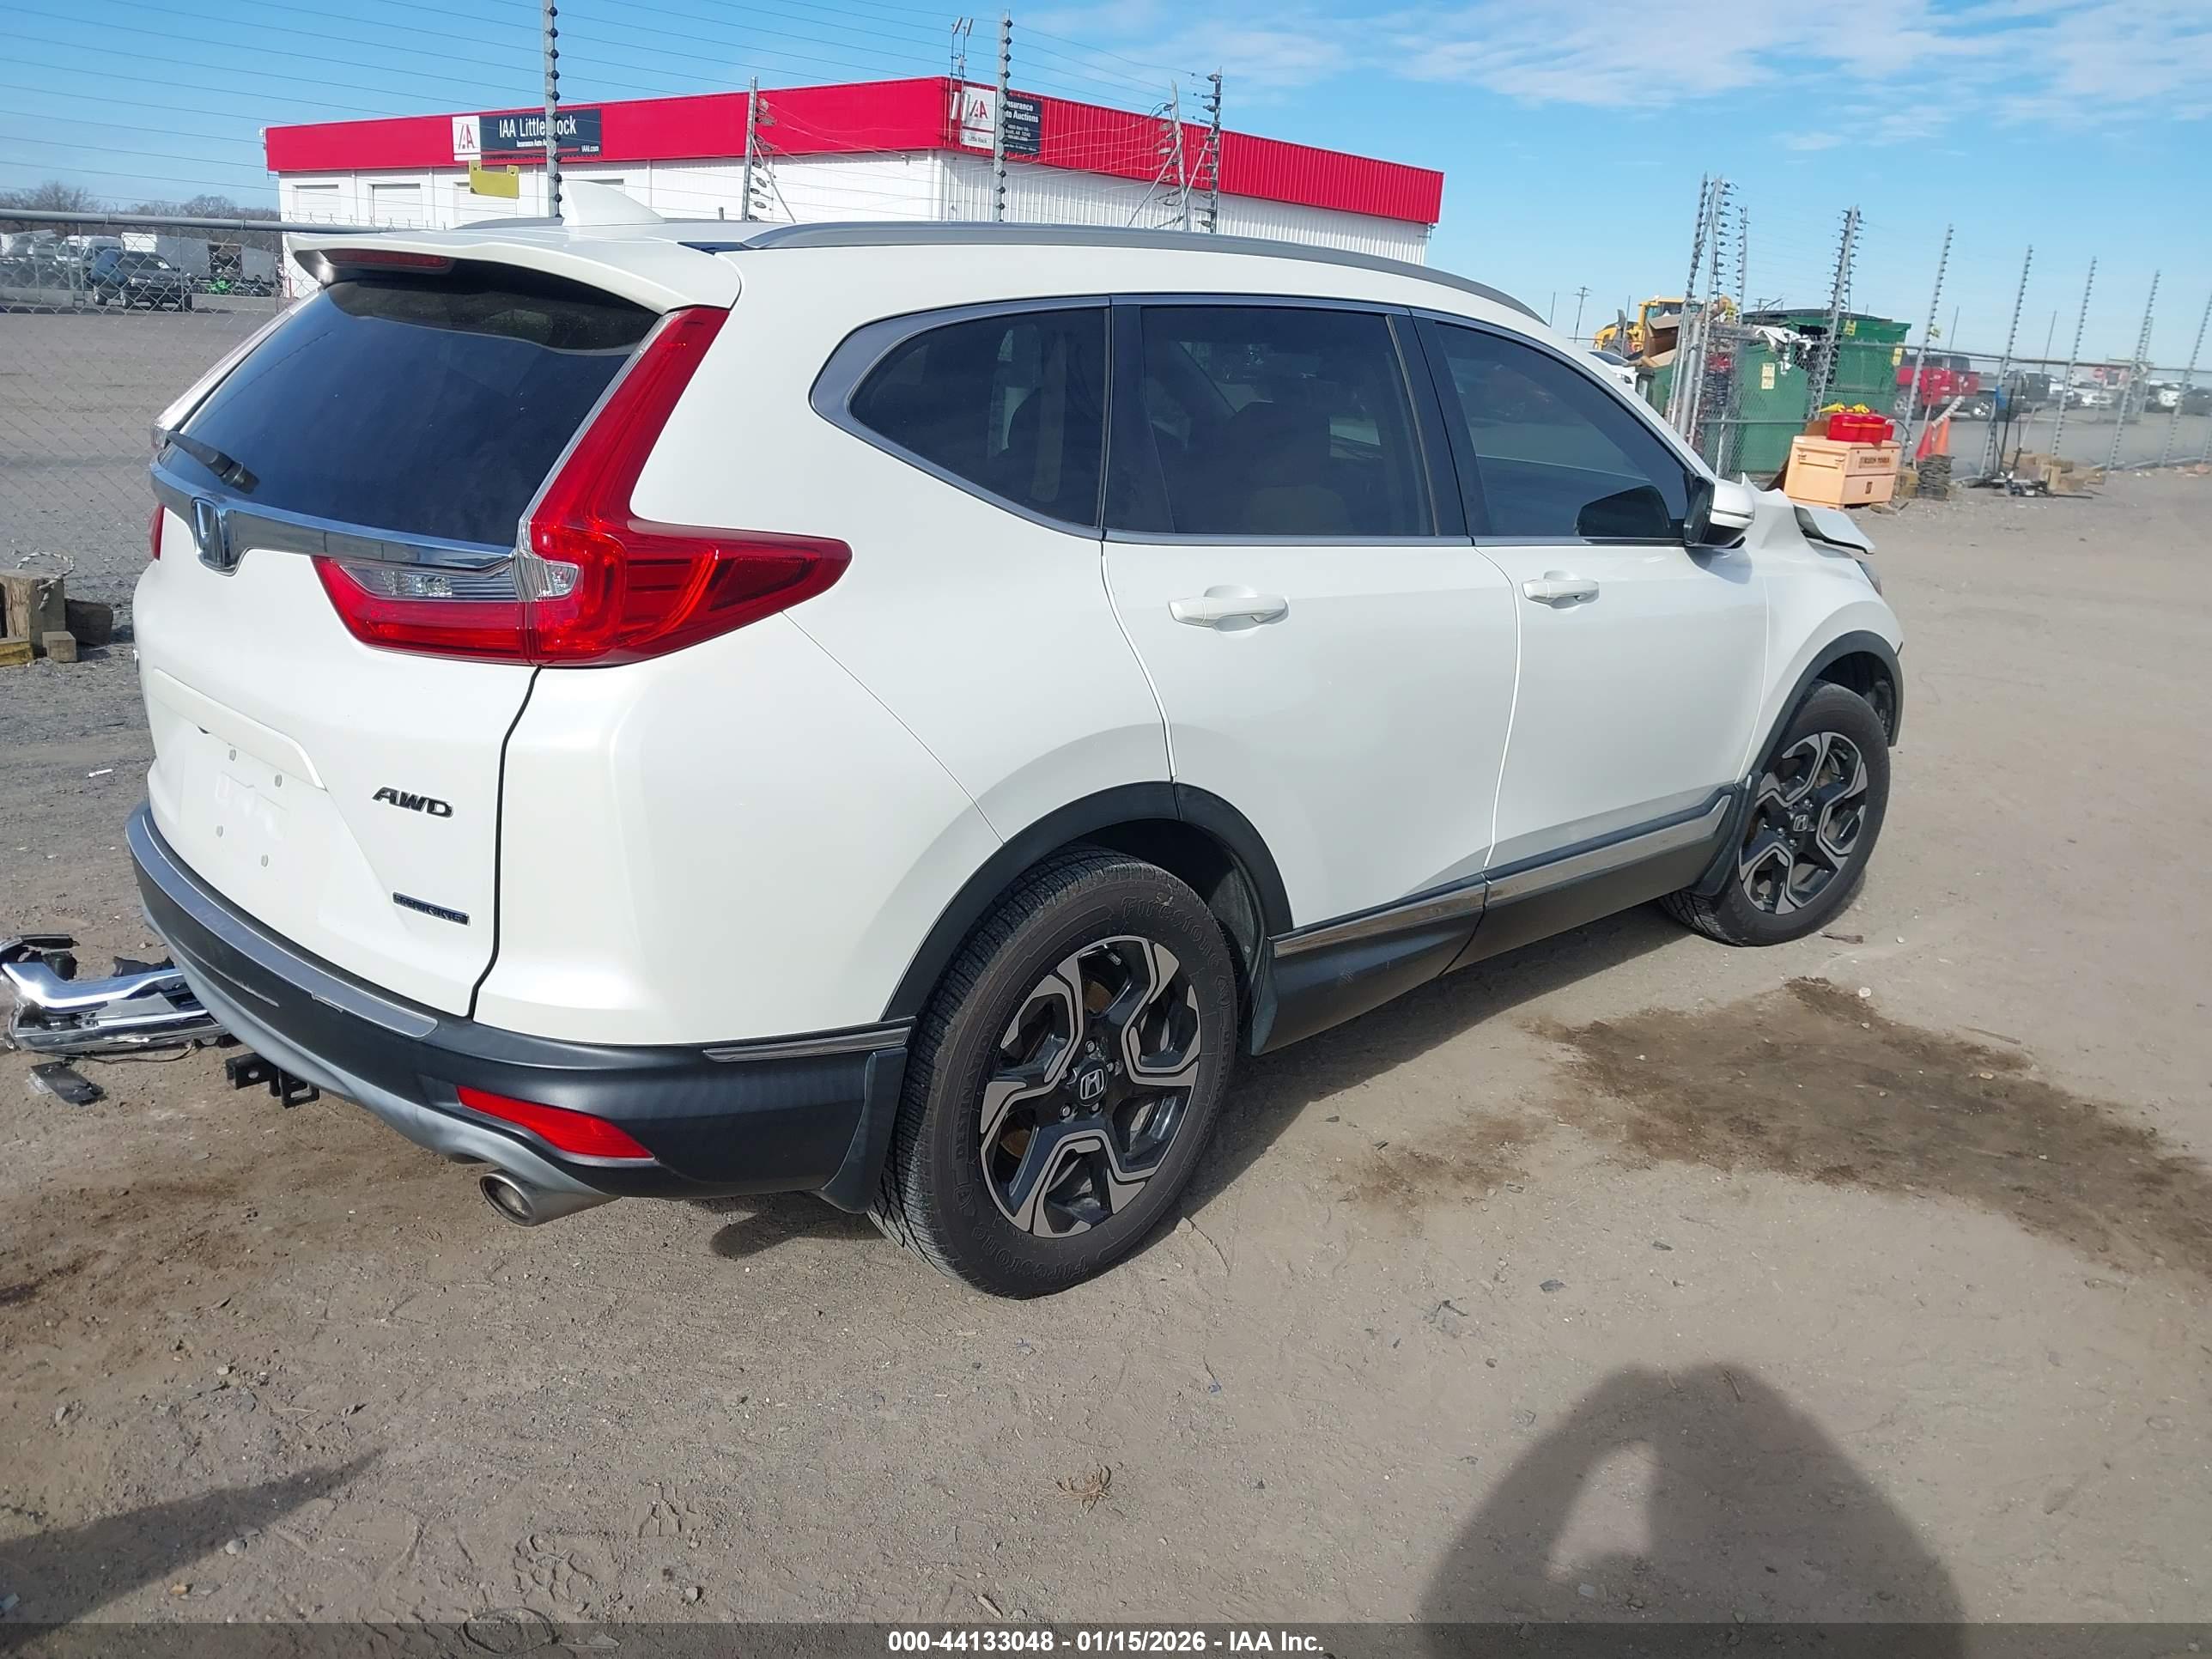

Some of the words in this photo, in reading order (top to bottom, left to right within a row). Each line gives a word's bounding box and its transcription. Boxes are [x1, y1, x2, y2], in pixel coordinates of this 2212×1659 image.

[1006, 100, 1034, 112] nsurance
[1013, 110, 1039, 123] Auctions
[499, 118, 516, 137] IAA
[520, 118, 545, 137] Little
[556, 115, 577, 135] ock
[373, 786, 454, 817] AWD
[1121, 896, 1224, 969] Firestone
